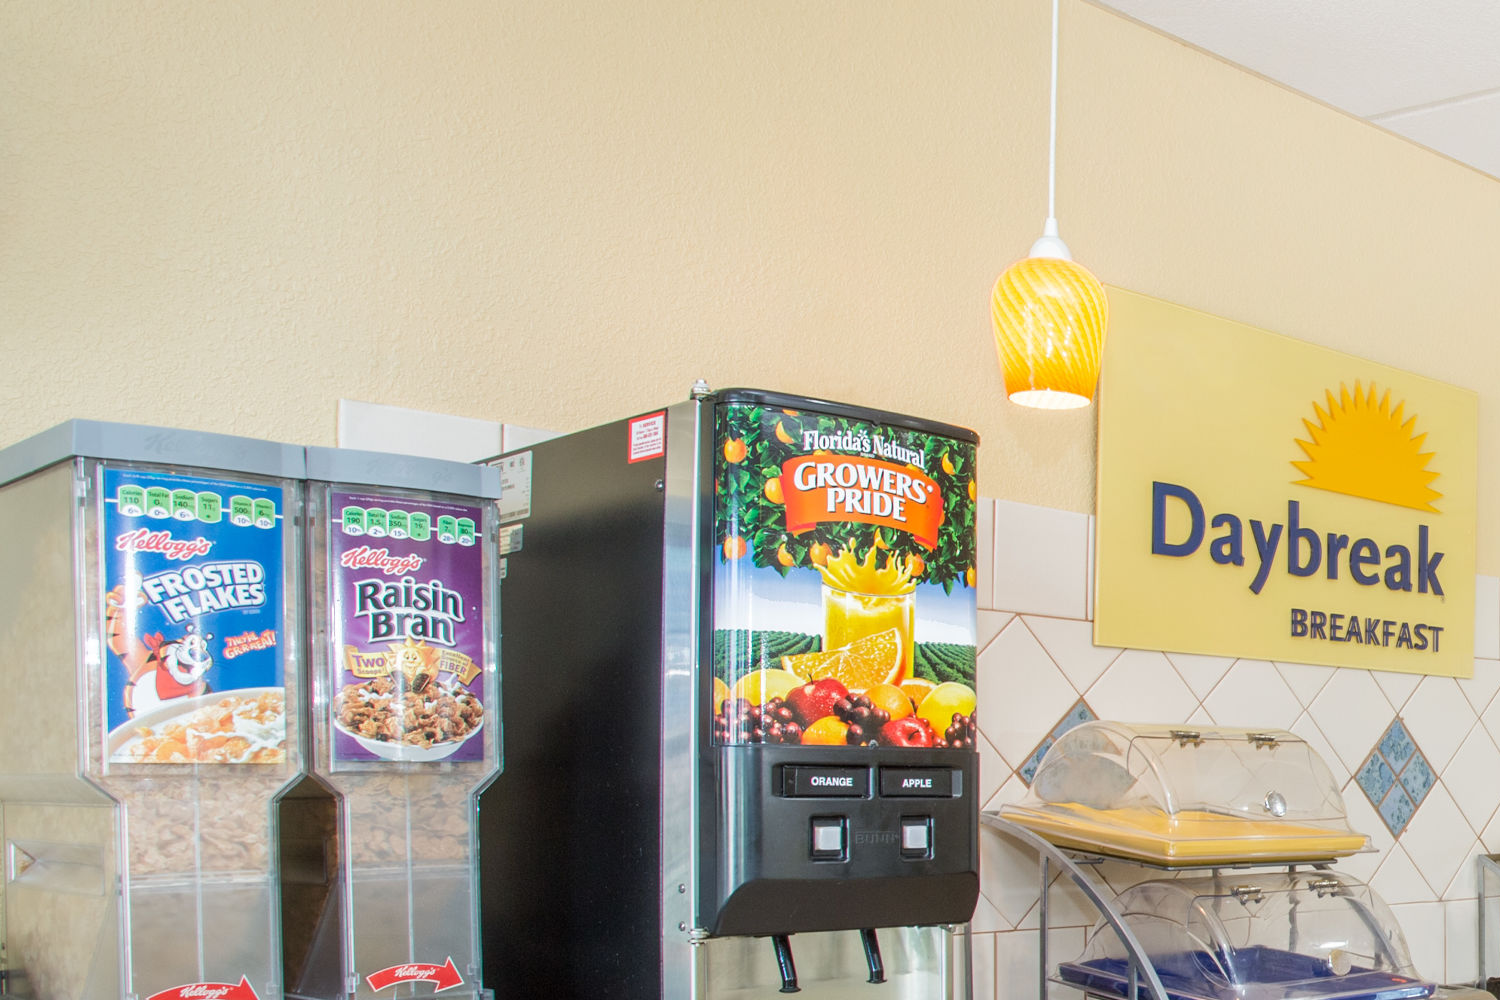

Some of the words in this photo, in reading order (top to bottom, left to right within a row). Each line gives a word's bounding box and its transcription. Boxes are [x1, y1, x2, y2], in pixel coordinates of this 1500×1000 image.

[803, 430, 871, 453] Florida's
[873, 435, 926, 468] Natural
[794, 462, 934, 504] GROWERS'
[827, 487, 907, 522] PRIDE
[117, 529, 212, 559] Kellogg's
[1151, 481, 1446, 595] Daybreak
[341, 547, 422, 574] Kellogg's
[142, 563, 264, 604] FROSTED
[355, 577, 464, 622] Raisin
[163, 584, 266, 623] FLAKES
[370, 610, 455, 646] Bran
[1291, 608, 1445, 653] BREAKFAST
[440, 660, 467, 675] FIBER
[811, 777, 853, 787] ORANGE
[902, 778, 932, 788] APPLE
[395, 966, 436, 979] Kellogg's
[180, 986, 229, 999] Kellogg's
